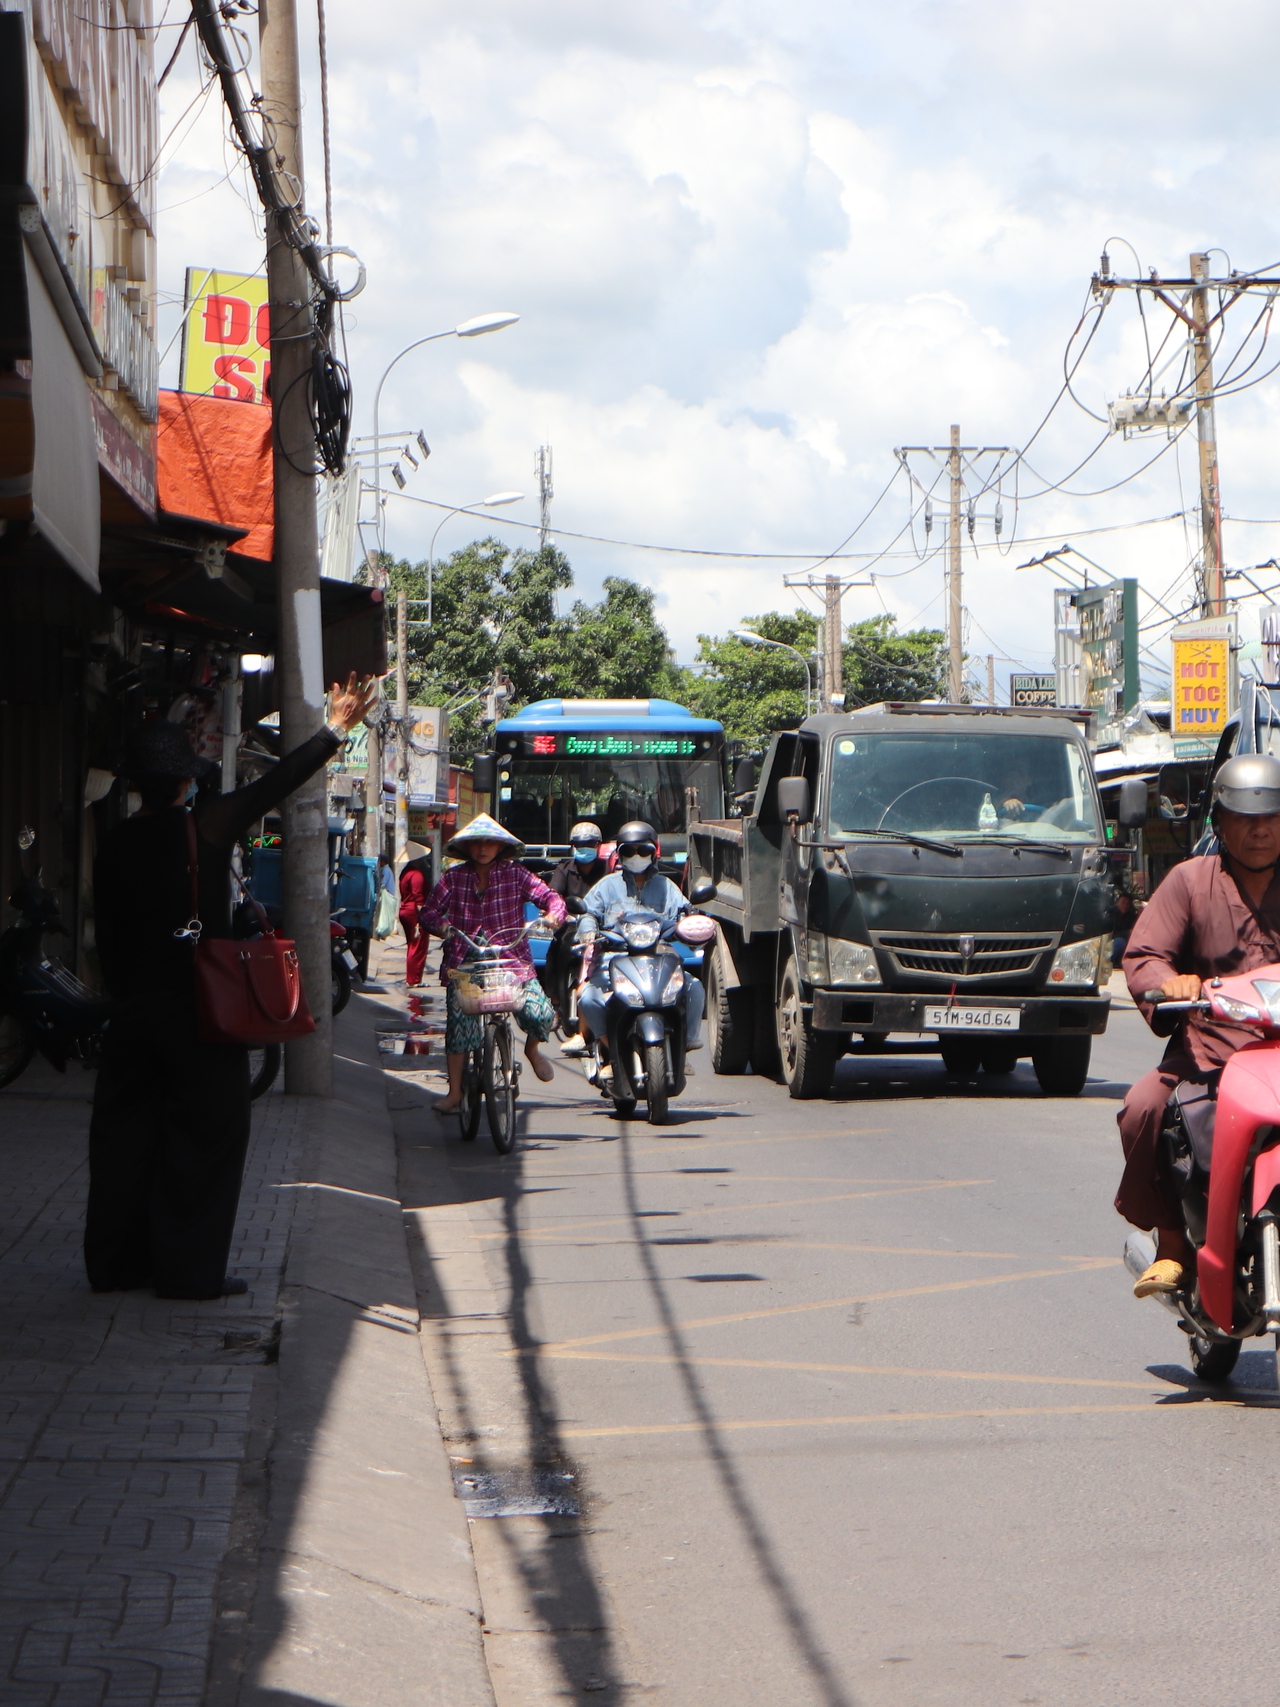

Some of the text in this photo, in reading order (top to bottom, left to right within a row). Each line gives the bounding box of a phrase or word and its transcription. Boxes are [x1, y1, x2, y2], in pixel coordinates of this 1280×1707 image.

[1180, 659, 1221, 679] HỚT
[1038, 676, 1056, 691] LIB
[1181, 684, 1221, 703] TÓC
[1181, 707, 1221, 724] HUY
[933, 1011, 1012, 1026] 51M-940.64
